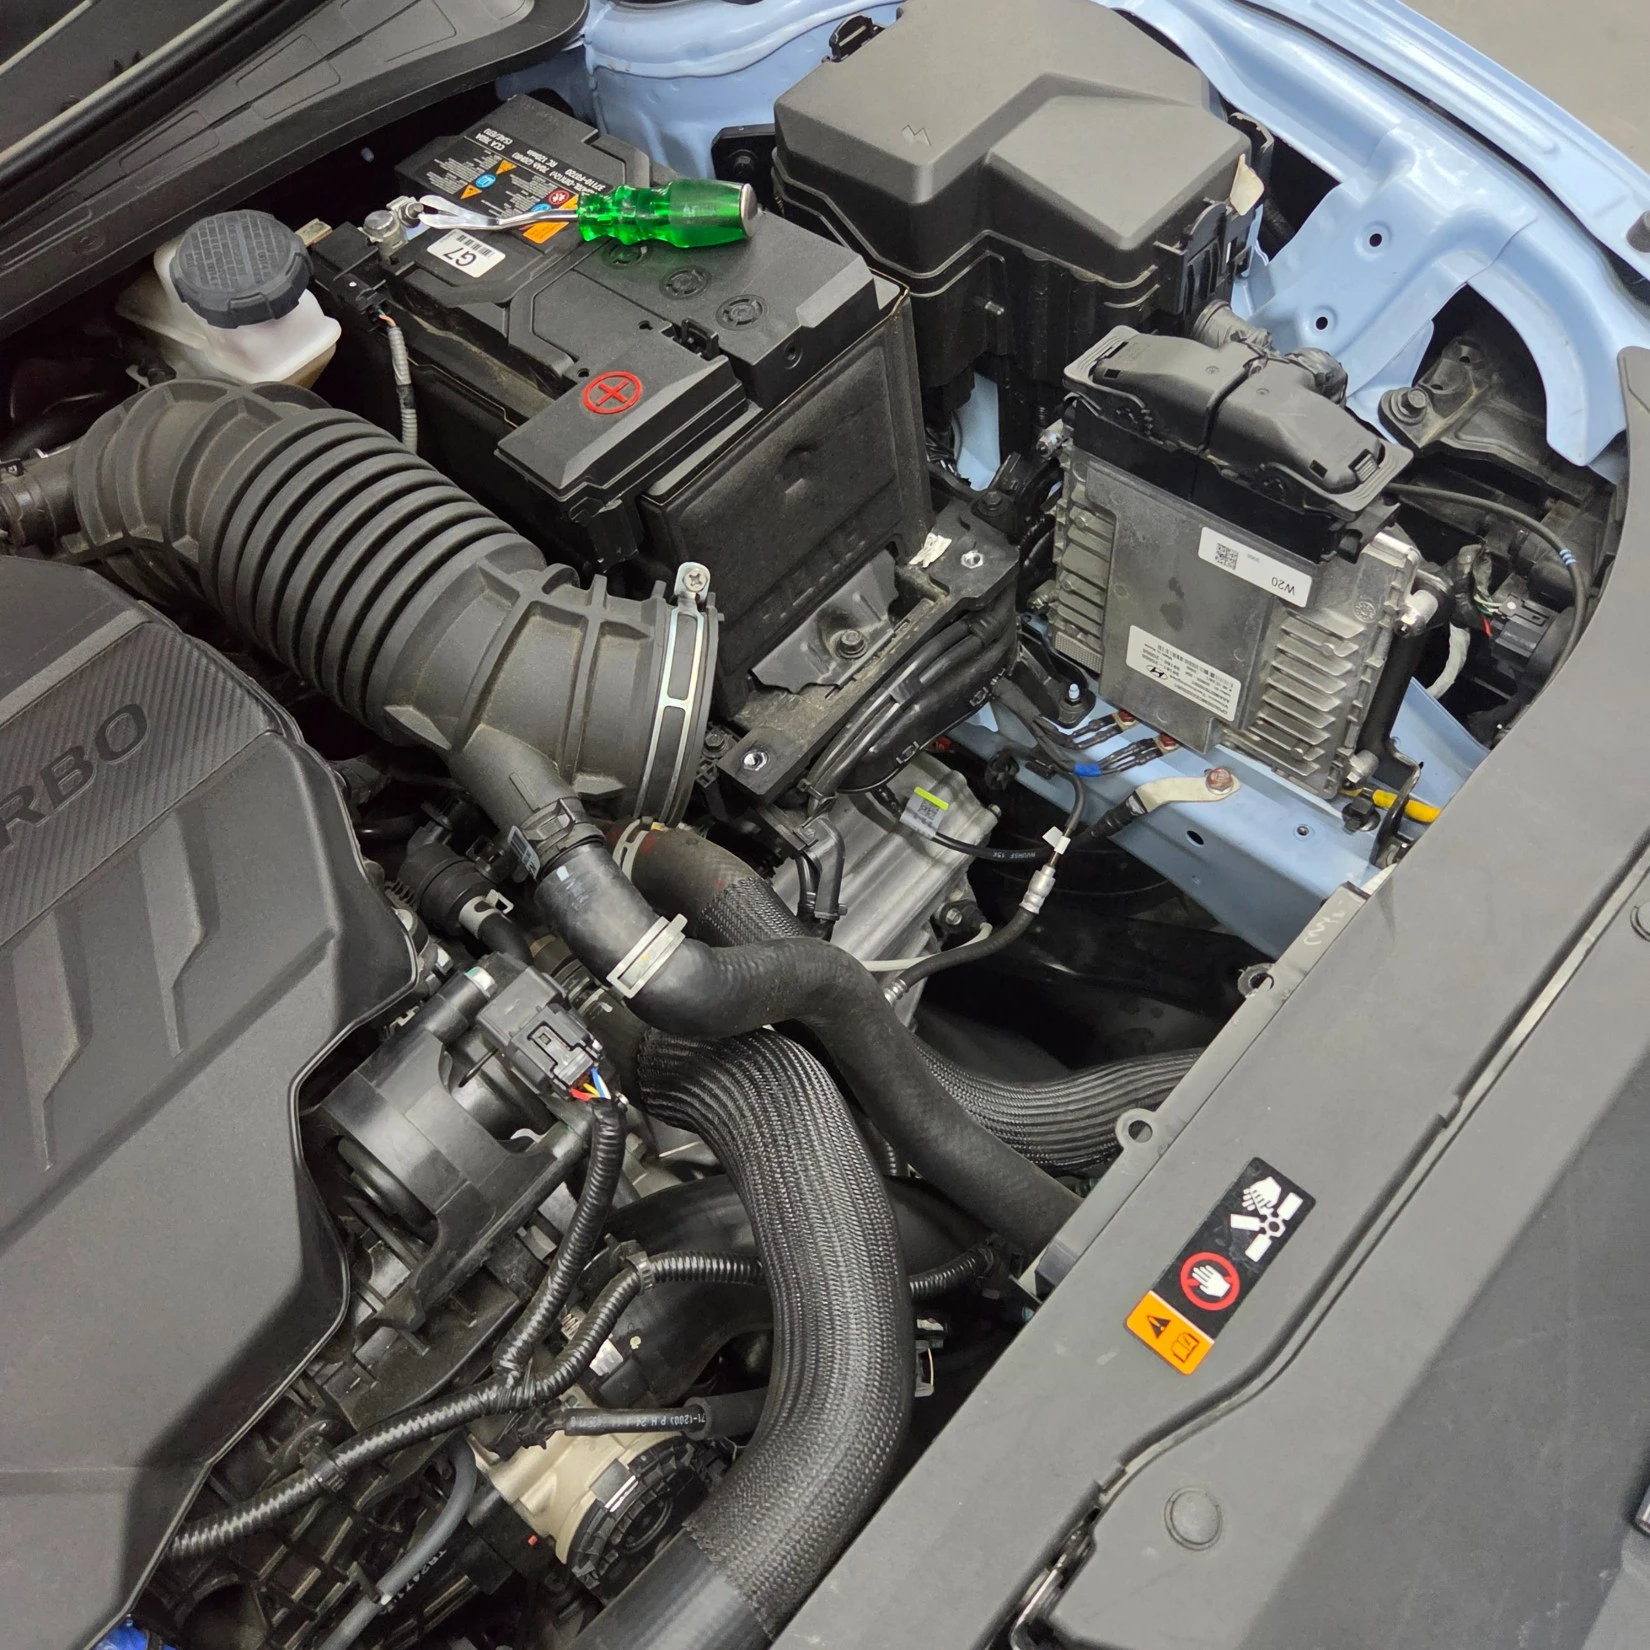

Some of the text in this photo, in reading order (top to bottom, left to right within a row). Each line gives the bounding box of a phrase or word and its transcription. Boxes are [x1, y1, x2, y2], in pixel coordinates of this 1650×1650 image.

[490, 141, 505, 150] CCA
[442, 247, 477, 267] G7
[1272, 576, 1295, 595] W20
[0, 704, 147, 850] RBO
